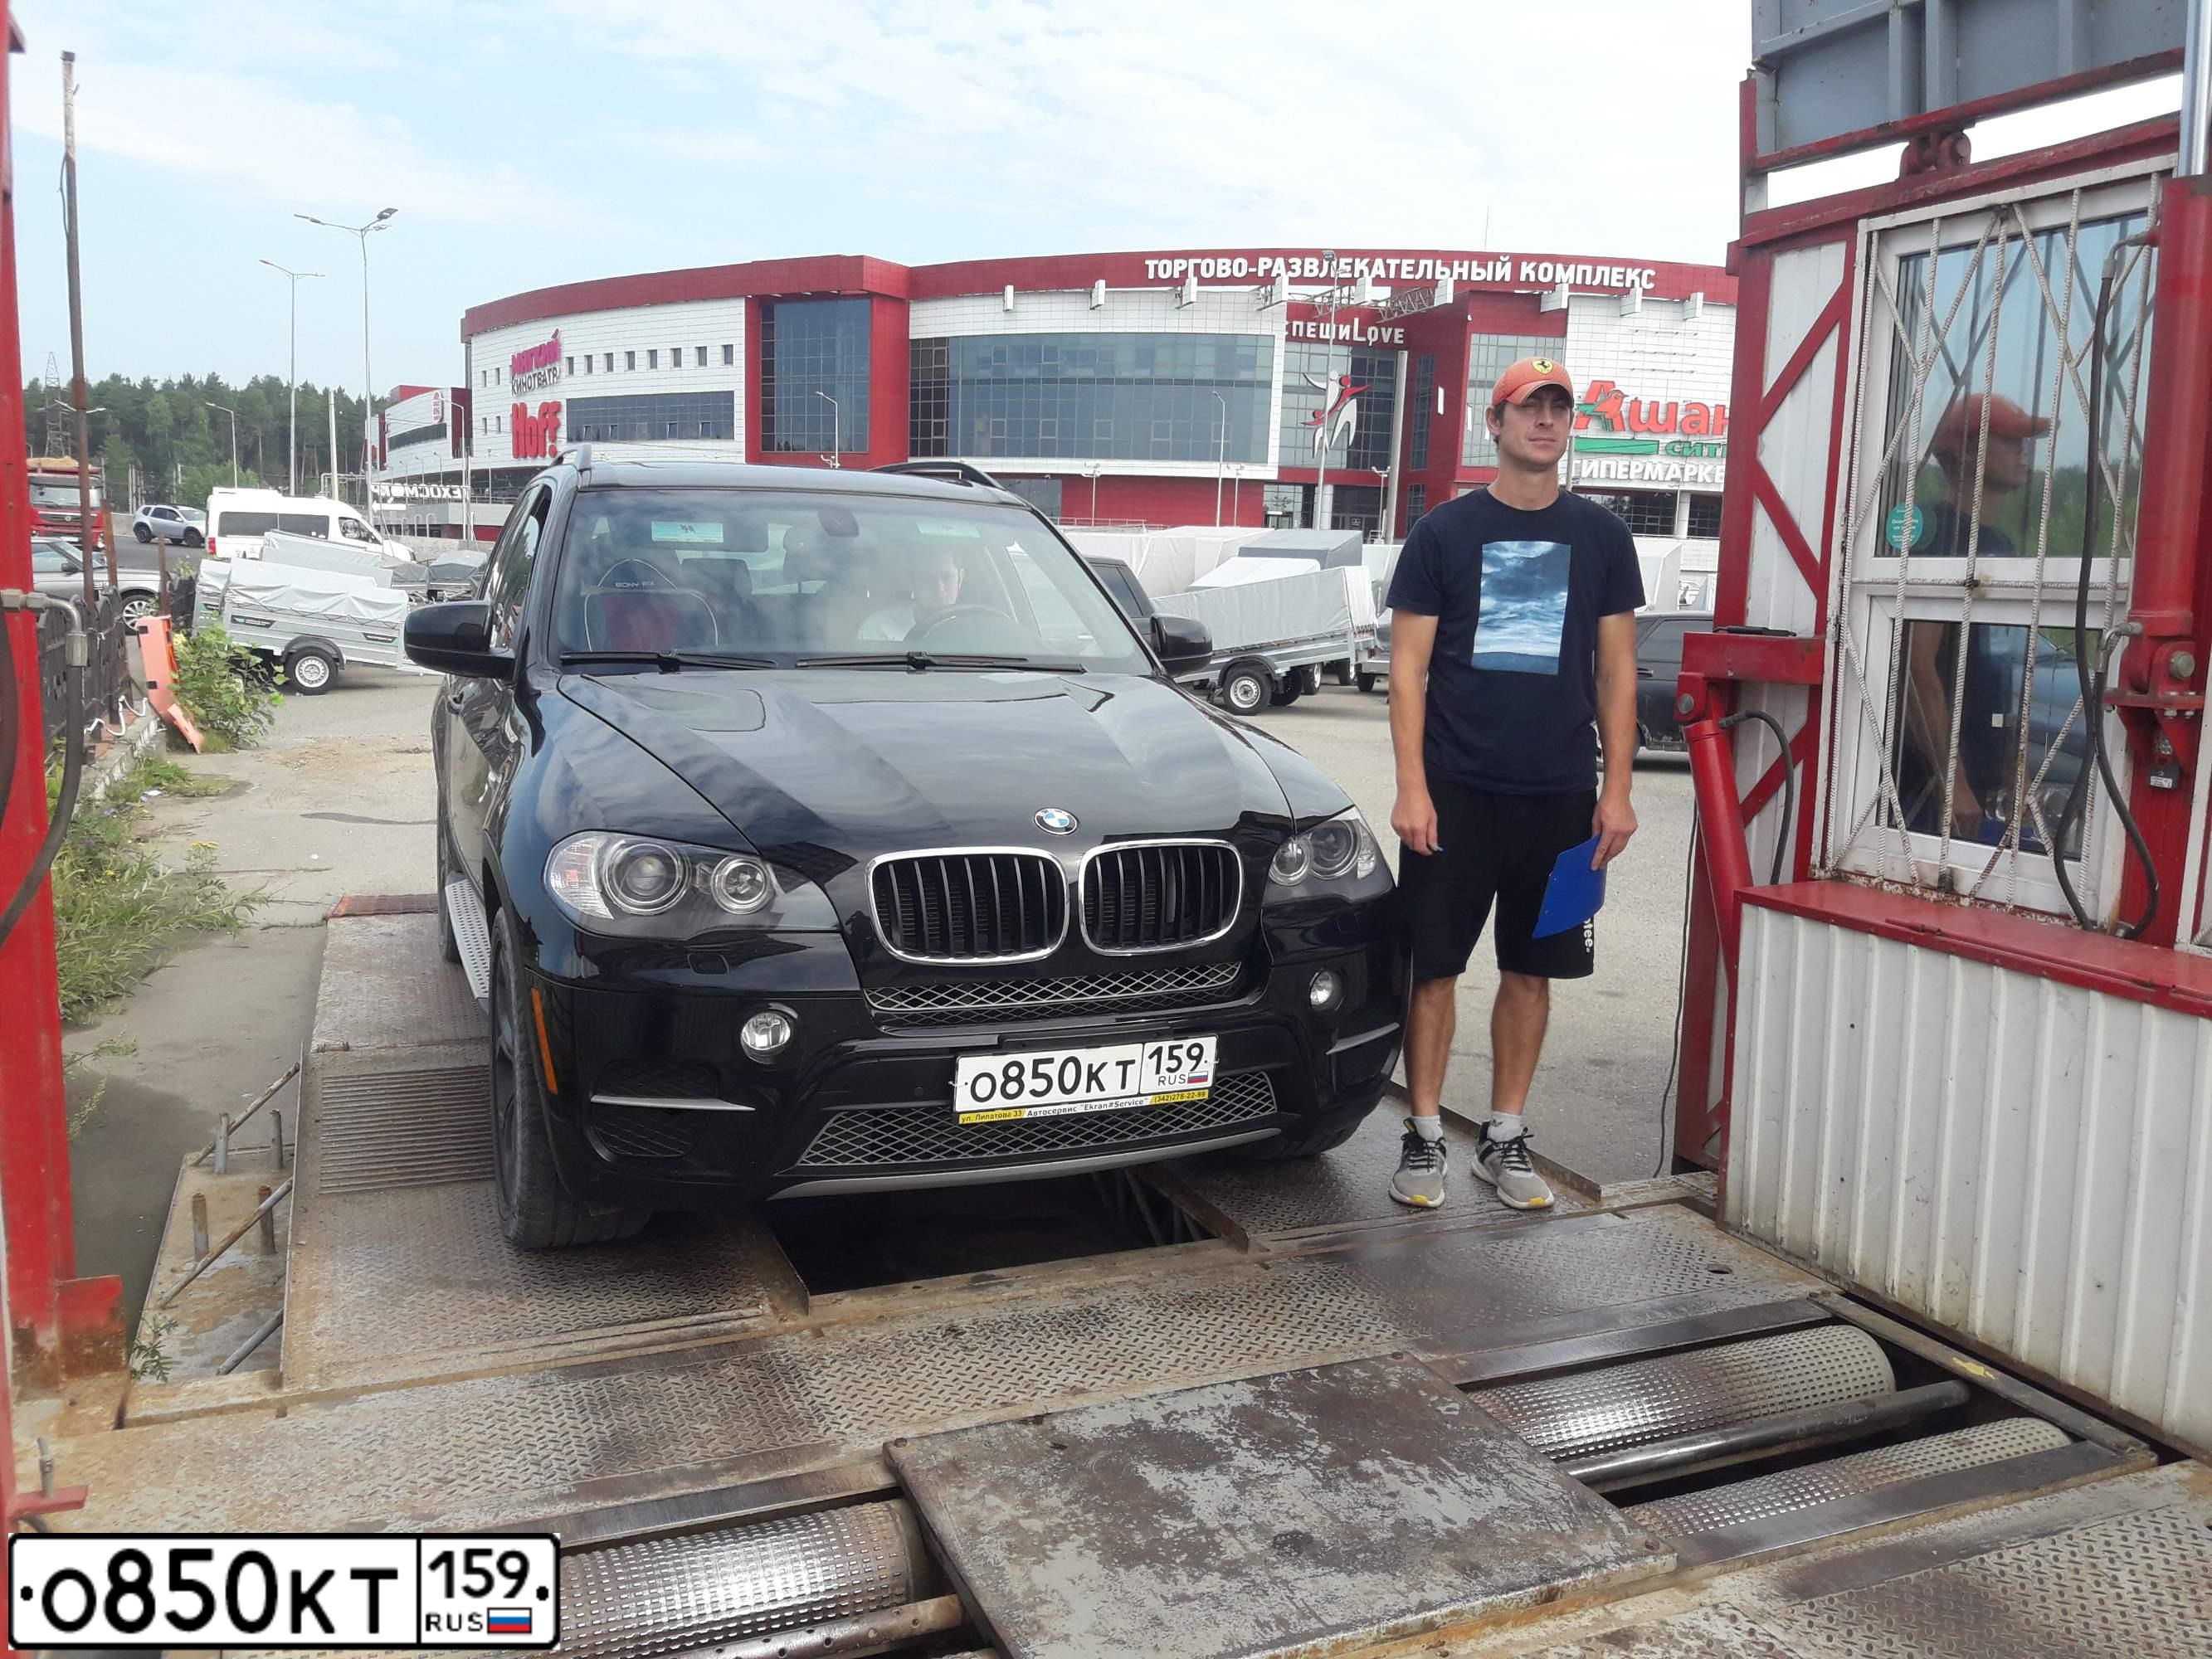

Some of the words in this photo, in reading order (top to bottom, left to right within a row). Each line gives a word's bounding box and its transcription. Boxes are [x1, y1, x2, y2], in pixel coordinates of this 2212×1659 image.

[1144, 255, 1512, 282] ТОРГОВО-РАЗВЛЕКАТЕЛЬНЫЙ
[1519, 261, 1657, 289] КОМПЛЕКС
[1286, 318, 1404, 346] ПЕШИLOVE
[511, 367, 559, 396] КИНОТЕАТР
[969, 1055, 1136, 1103] О850КТ
[1147, 1042, 1205, 1075] 159
[1157, 1073, 1186, 1087] RUS
[975, 1111, 1011, 1121] Липатова
[1013, 1109, 1023, 1117] 33
[1027, 1107, 1078, 1117] Автосервис
[1153, 1091, 1206, 1104] (342)278-22-99
